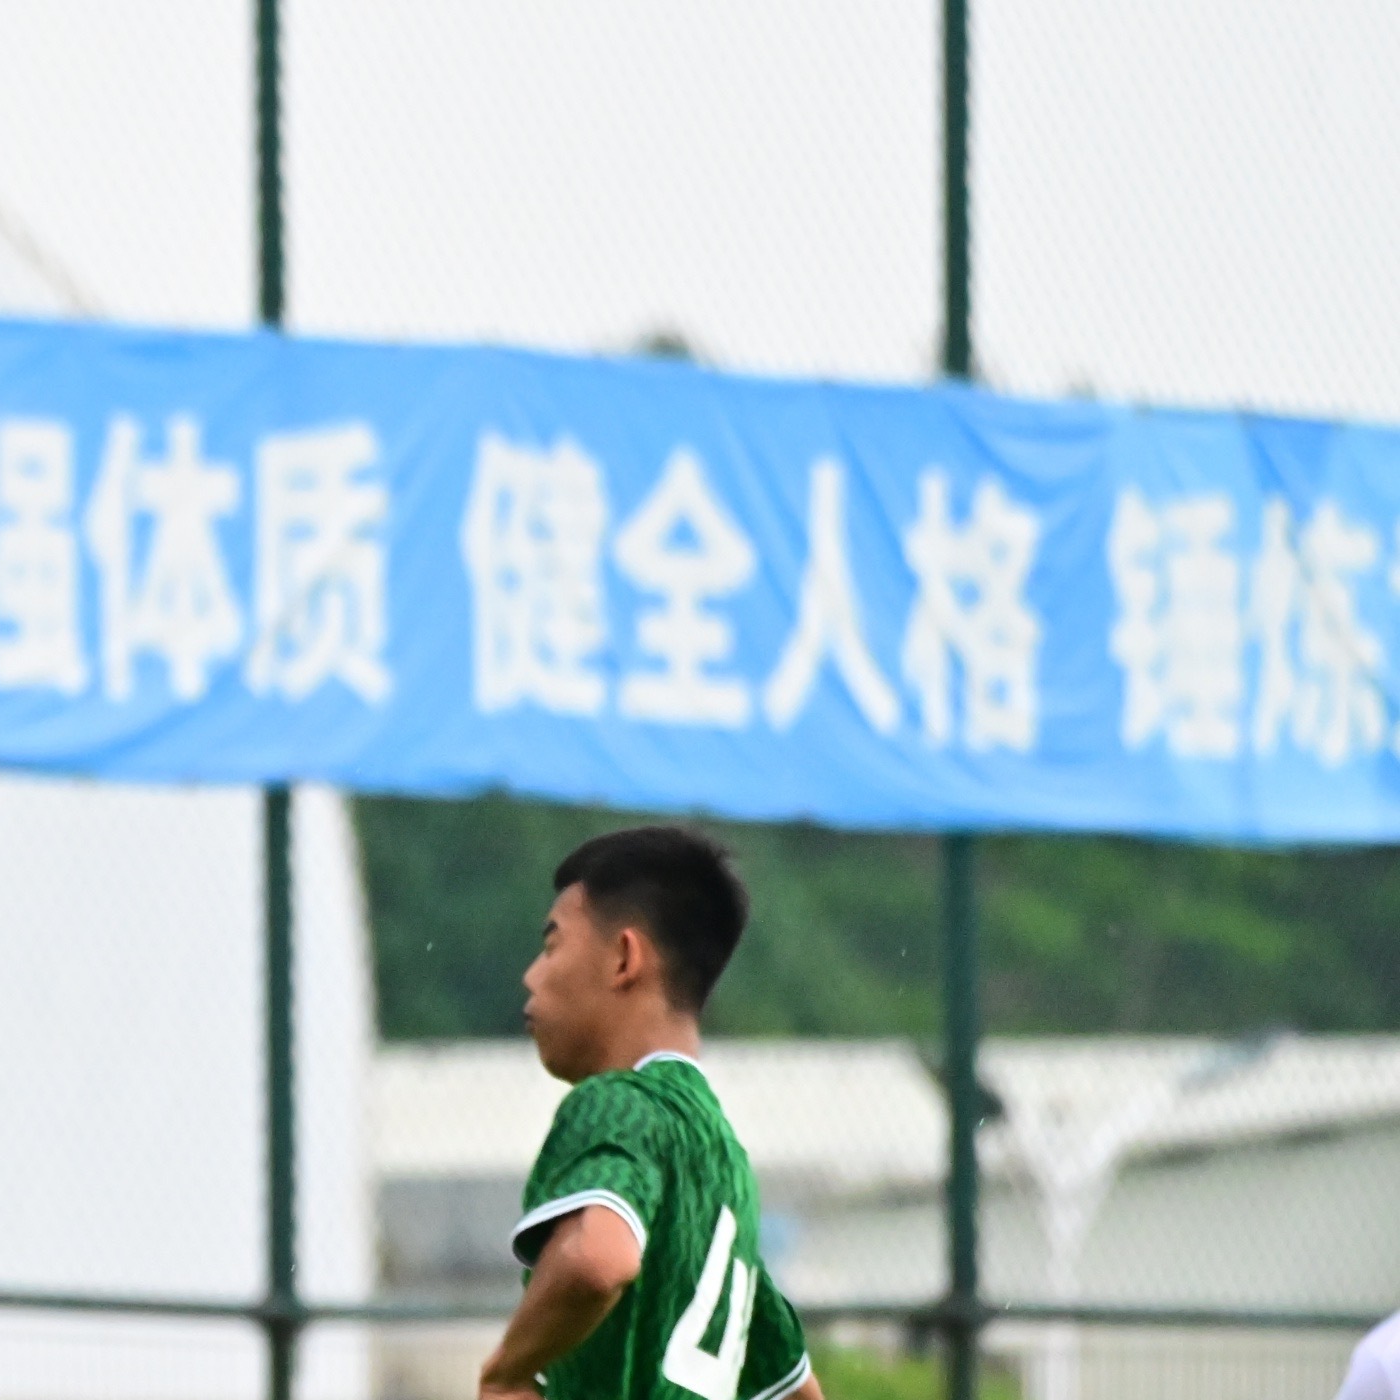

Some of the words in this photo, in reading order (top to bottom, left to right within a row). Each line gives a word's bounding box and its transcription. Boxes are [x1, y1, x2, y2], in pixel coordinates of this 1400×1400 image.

[460, 432, 1042, 754] 健全人格
[1106, 484, 1400, 768] 锤炼
